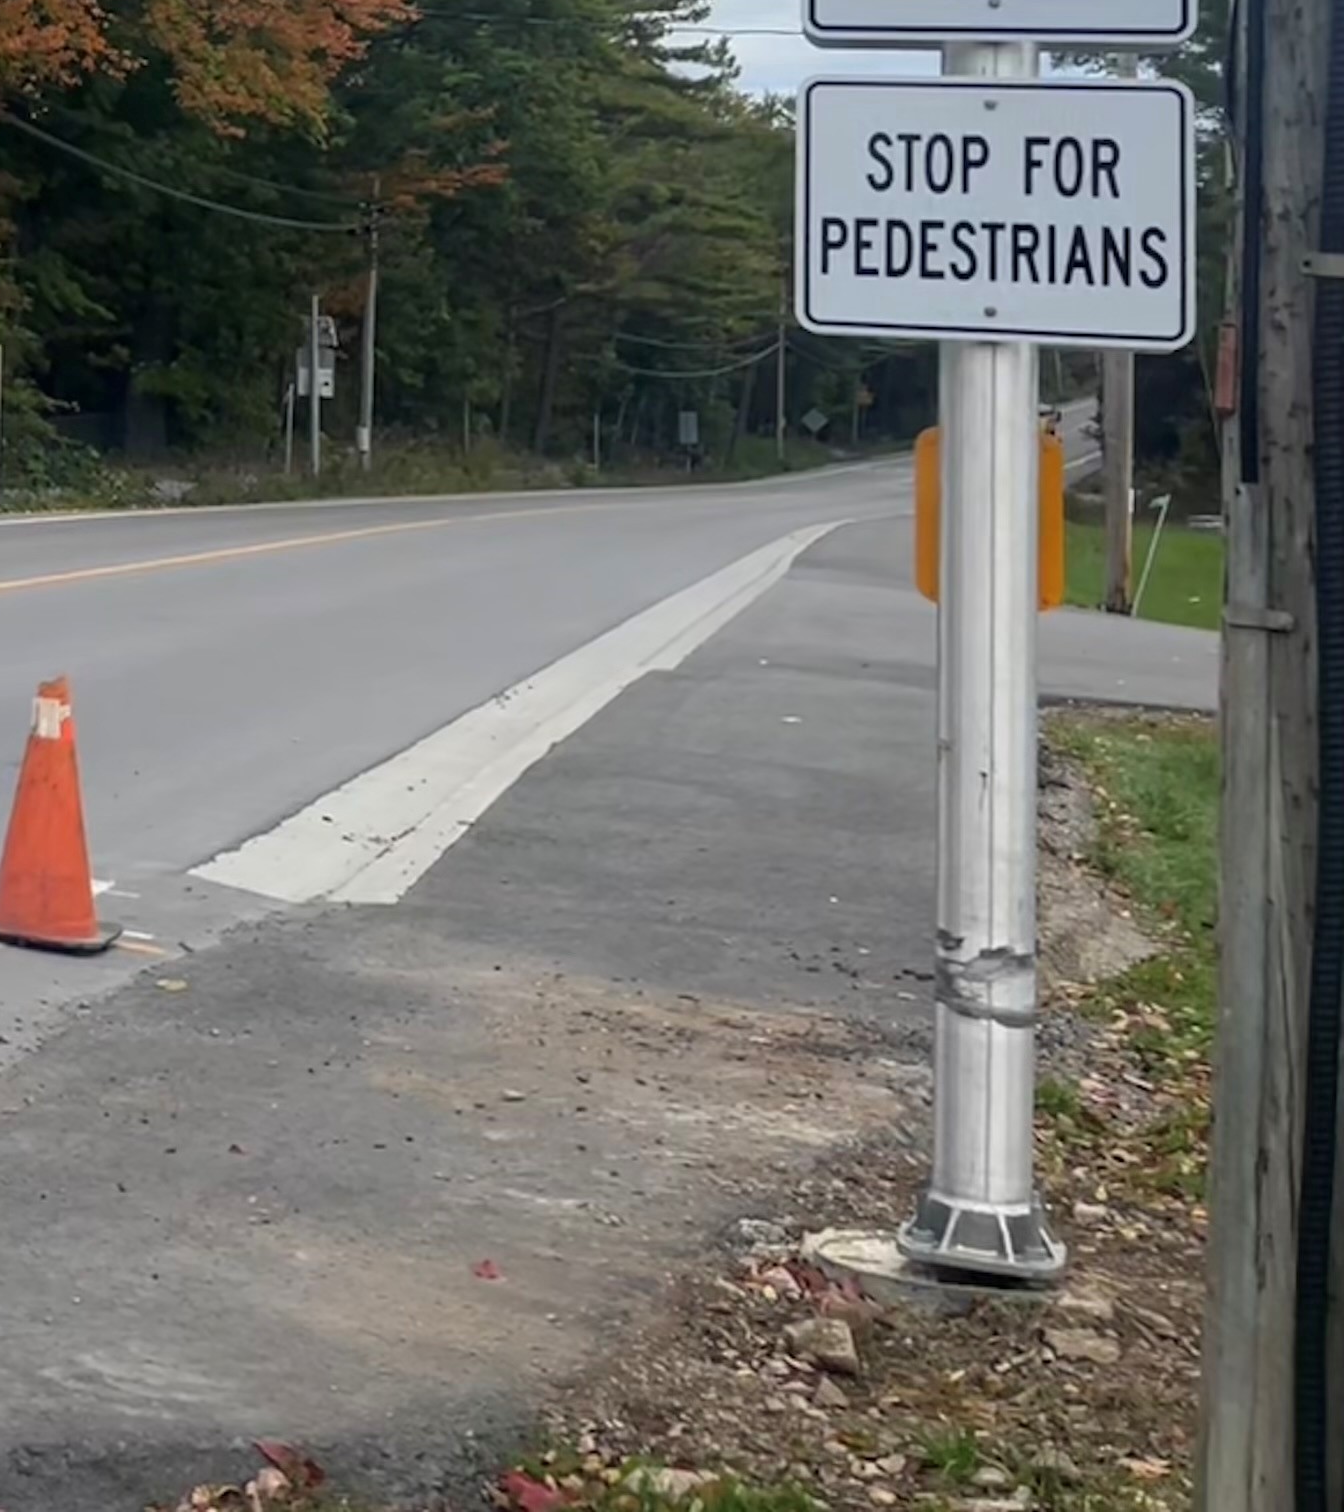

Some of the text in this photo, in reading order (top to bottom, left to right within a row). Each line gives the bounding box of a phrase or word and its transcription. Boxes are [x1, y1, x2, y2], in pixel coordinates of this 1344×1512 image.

[865, 132, 1121, 199] STOP FOR
[820, 217, 1169, 289] PEDESTRIANS
